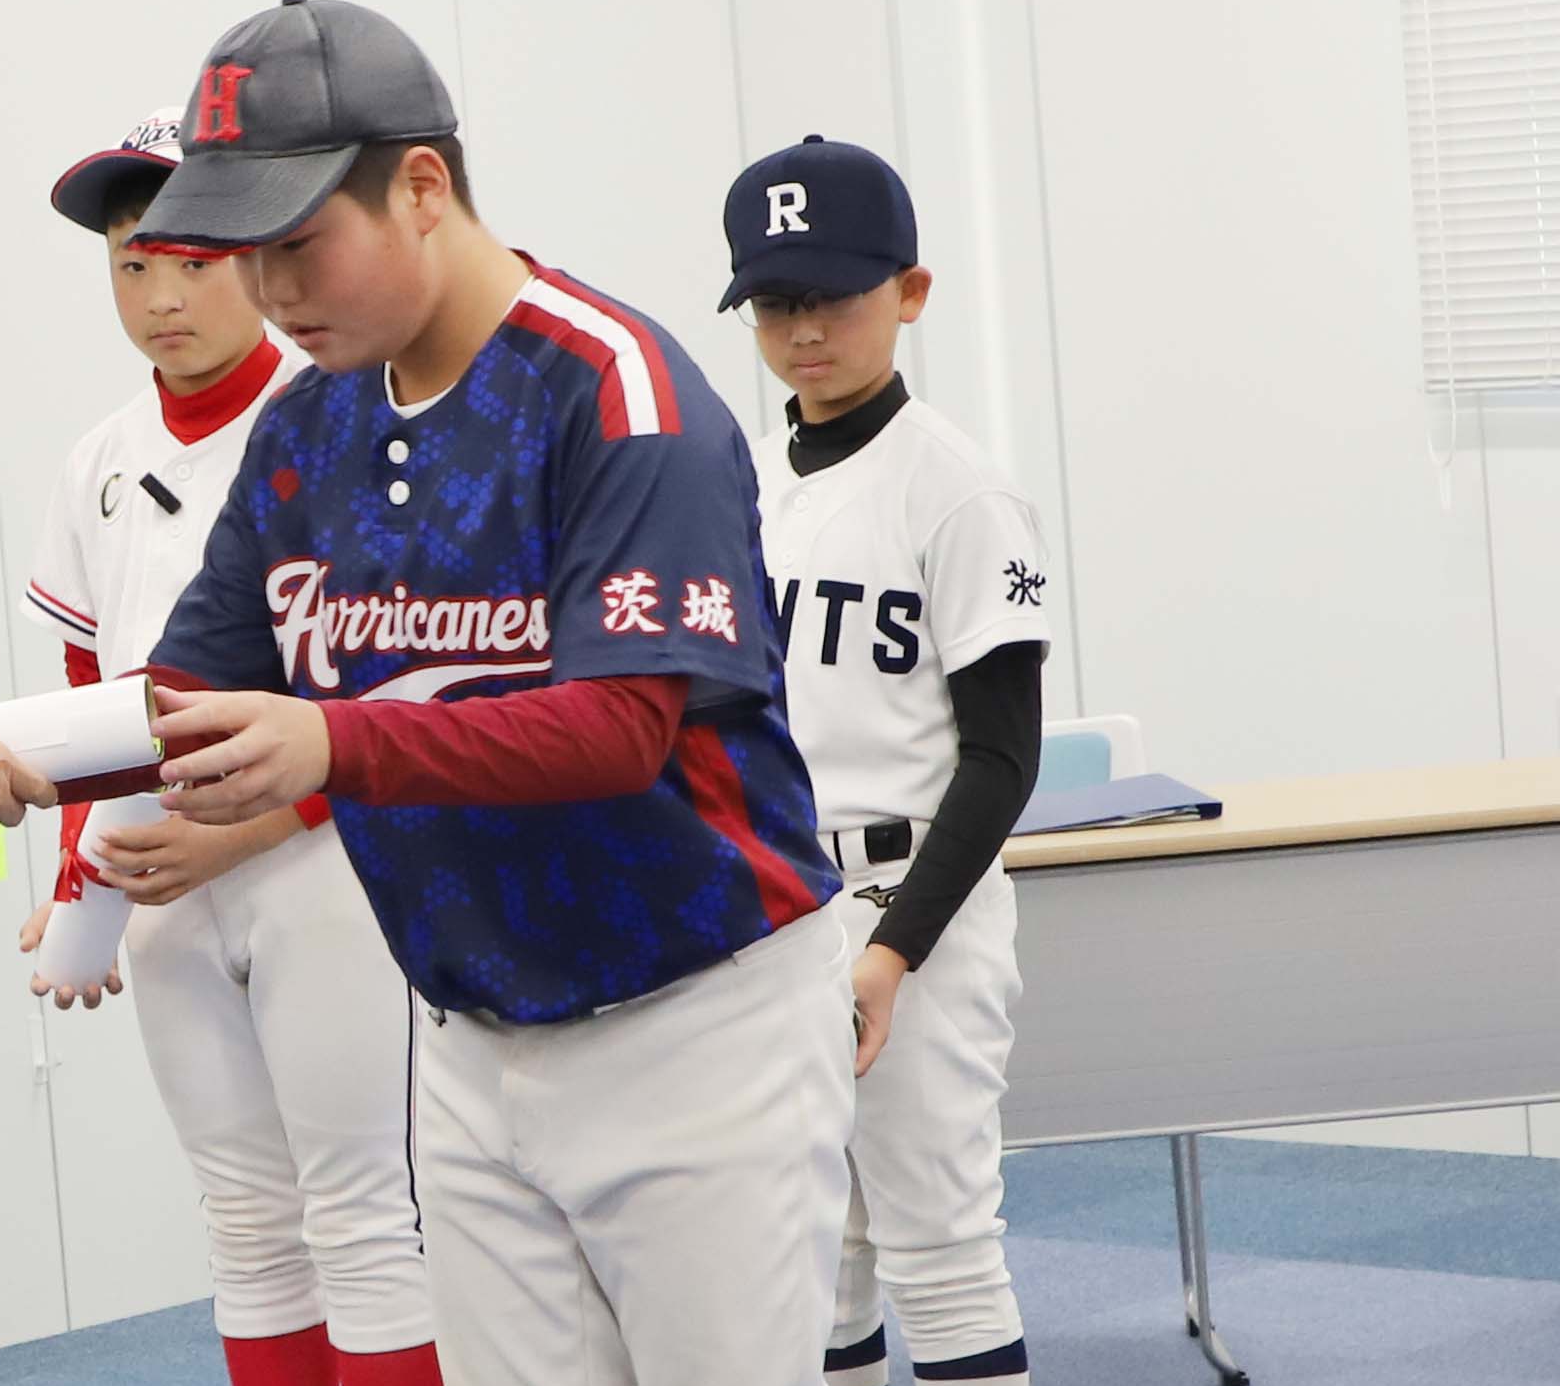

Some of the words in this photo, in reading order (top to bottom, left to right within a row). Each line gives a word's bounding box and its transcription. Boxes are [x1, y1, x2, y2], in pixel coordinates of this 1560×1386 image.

[192, 63, 254, 142] H
[765, 182, 810, 237] R
[601, 568, 738, 645] 茨城
